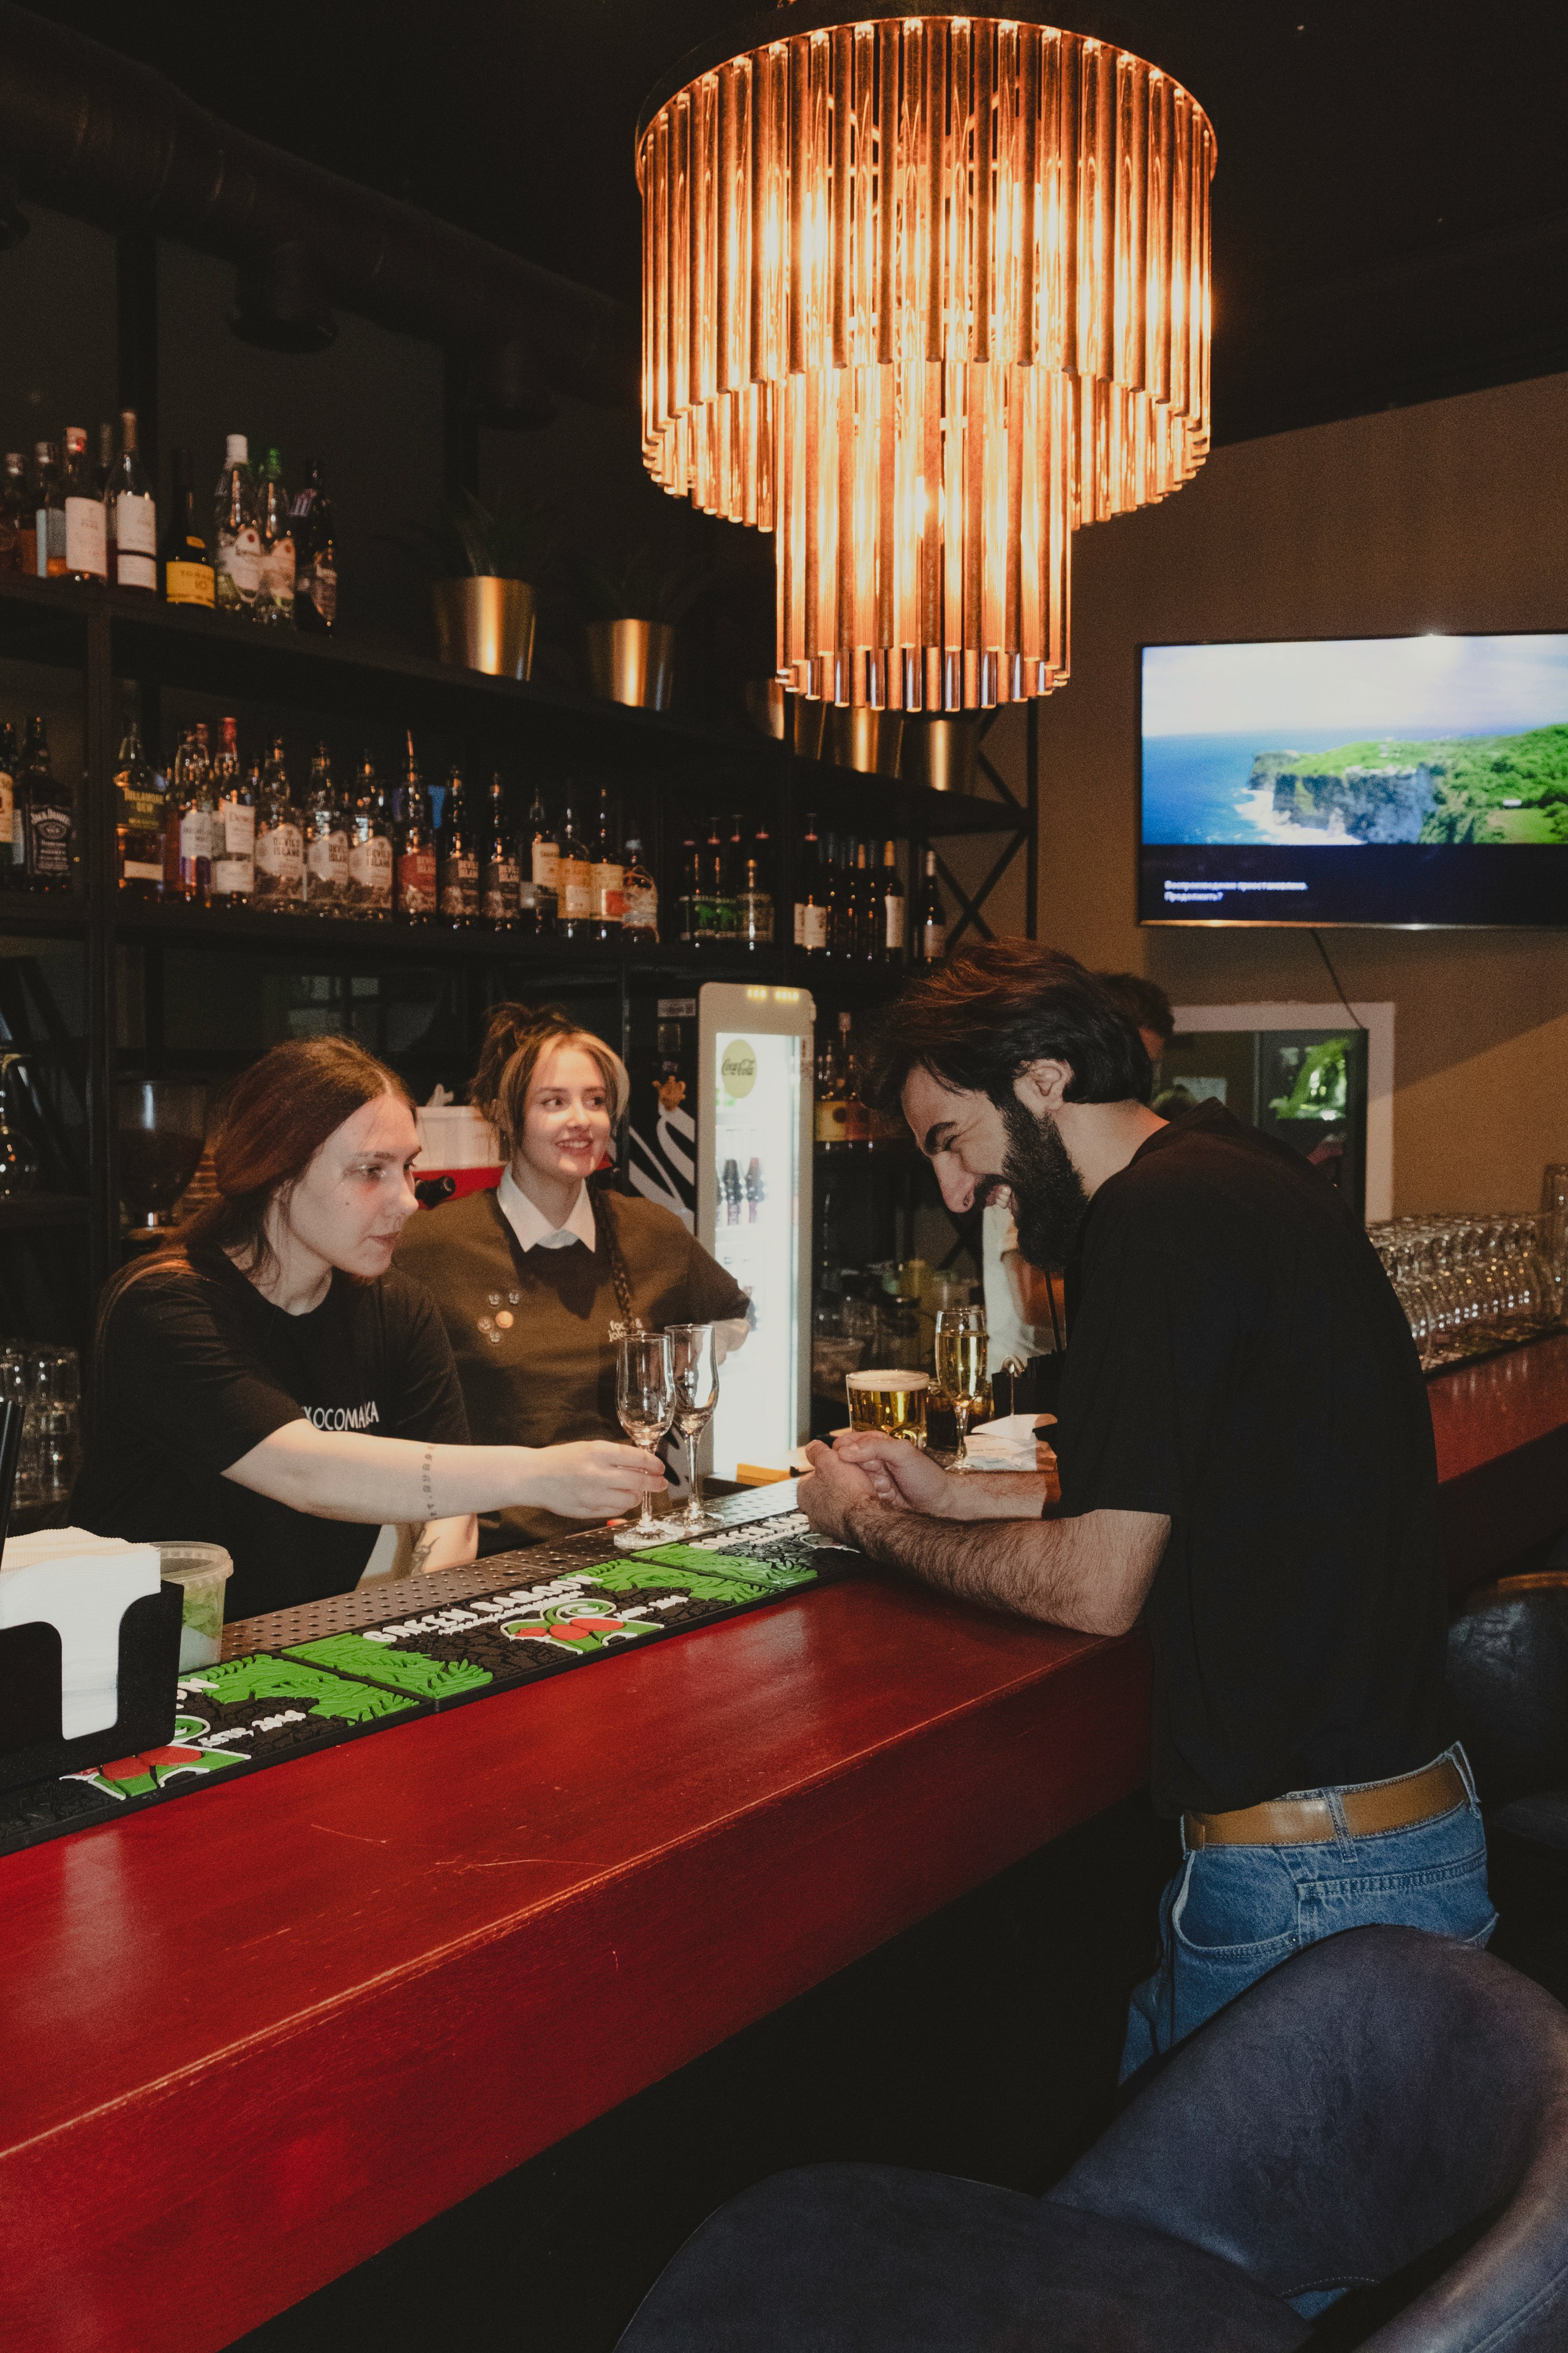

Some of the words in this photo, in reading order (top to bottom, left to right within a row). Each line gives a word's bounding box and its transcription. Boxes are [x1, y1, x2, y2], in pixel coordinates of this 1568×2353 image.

[301, 1401, 380, 1431] ХОСОМАКА
[363, 1608, 478, 1642] GREEN
[469, 1574, 604, 1613] BABOON
